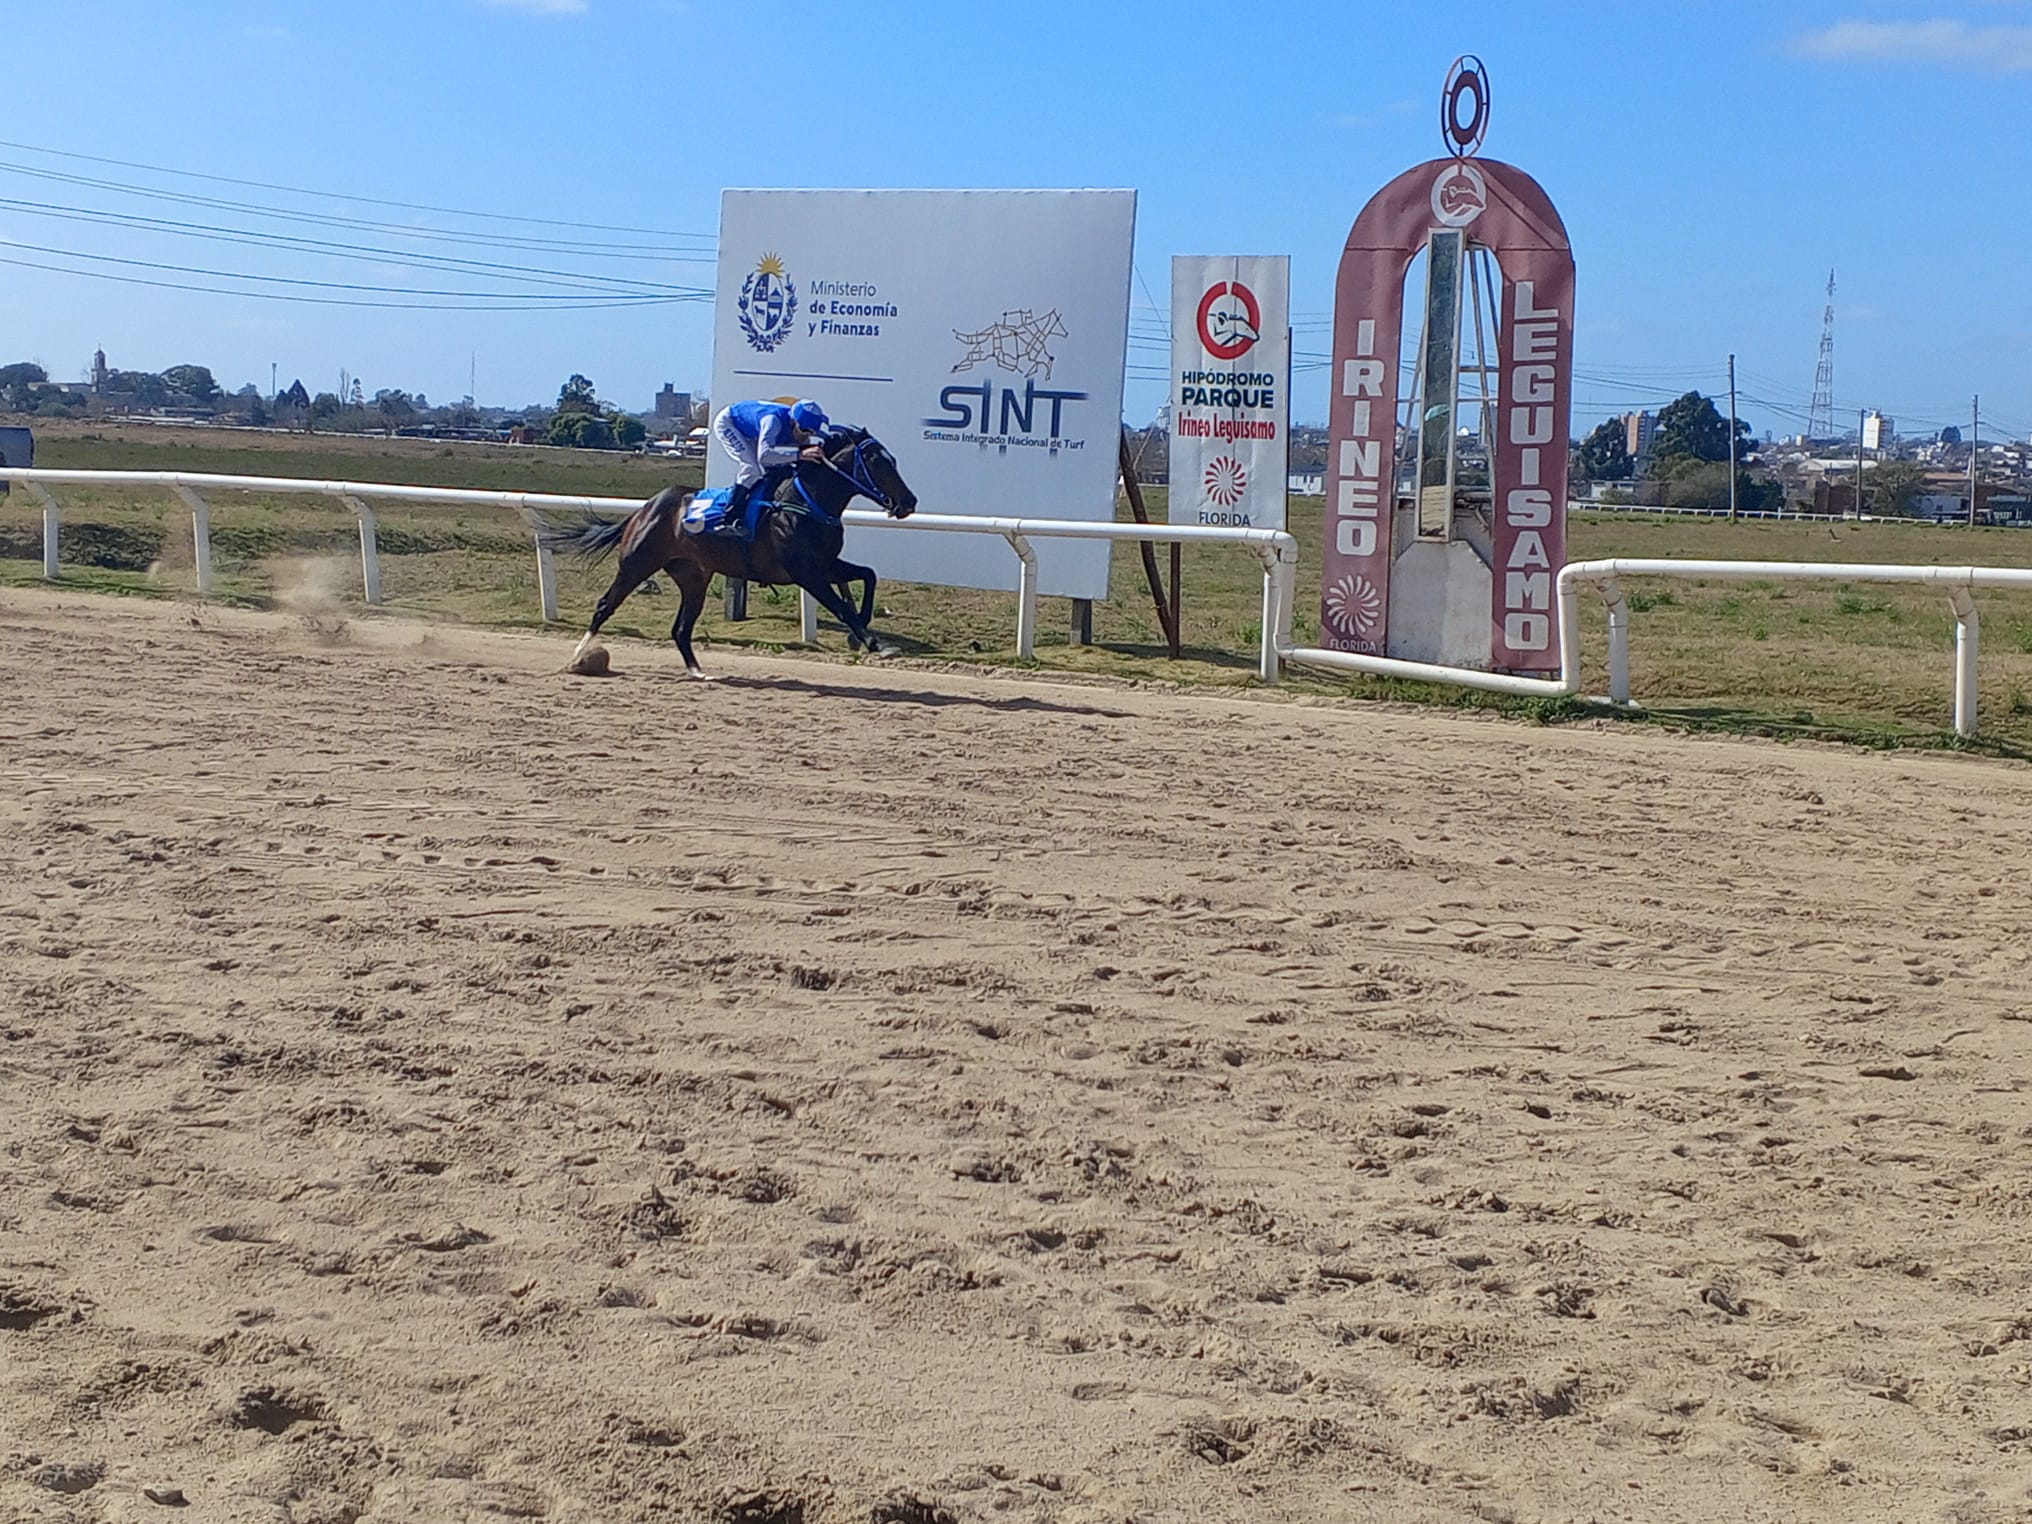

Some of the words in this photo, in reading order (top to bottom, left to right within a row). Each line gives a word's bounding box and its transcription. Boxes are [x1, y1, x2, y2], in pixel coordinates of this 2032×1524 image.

[810, 280, 877, 297] Ministerio
[809, 299, 826, 315] de
[830, 300, 898, 318] Economía
[807, 321, 817, 338] y
[820, 319, 880, 337] Finanzas
[1182, 367, 1275, 386] HIPÓDROMO
[1181, 386, 1275, 409] PARQUE
[921, 378, 1089, 438] SINT
[1178, 409, 1211, 438] Irineo
[1213, 412, 1276, 444] Leguisamo
[923, 430, 960, 442] Sistema
[961, 432, 1006, 446] Integrado
[1007, 436, 1049, 448] Nacional
[1050, 438, 1062, 449] de
[1063, 439, 1085, 450] Turf
[1336, 319, 1385, 557] IRINEO
[1504, 281, 1559, 651] LEGUISAMO
[1199, 511, 1251, 527] FLORIDA
[1329, 638, 1377, 652] FLORIDA
